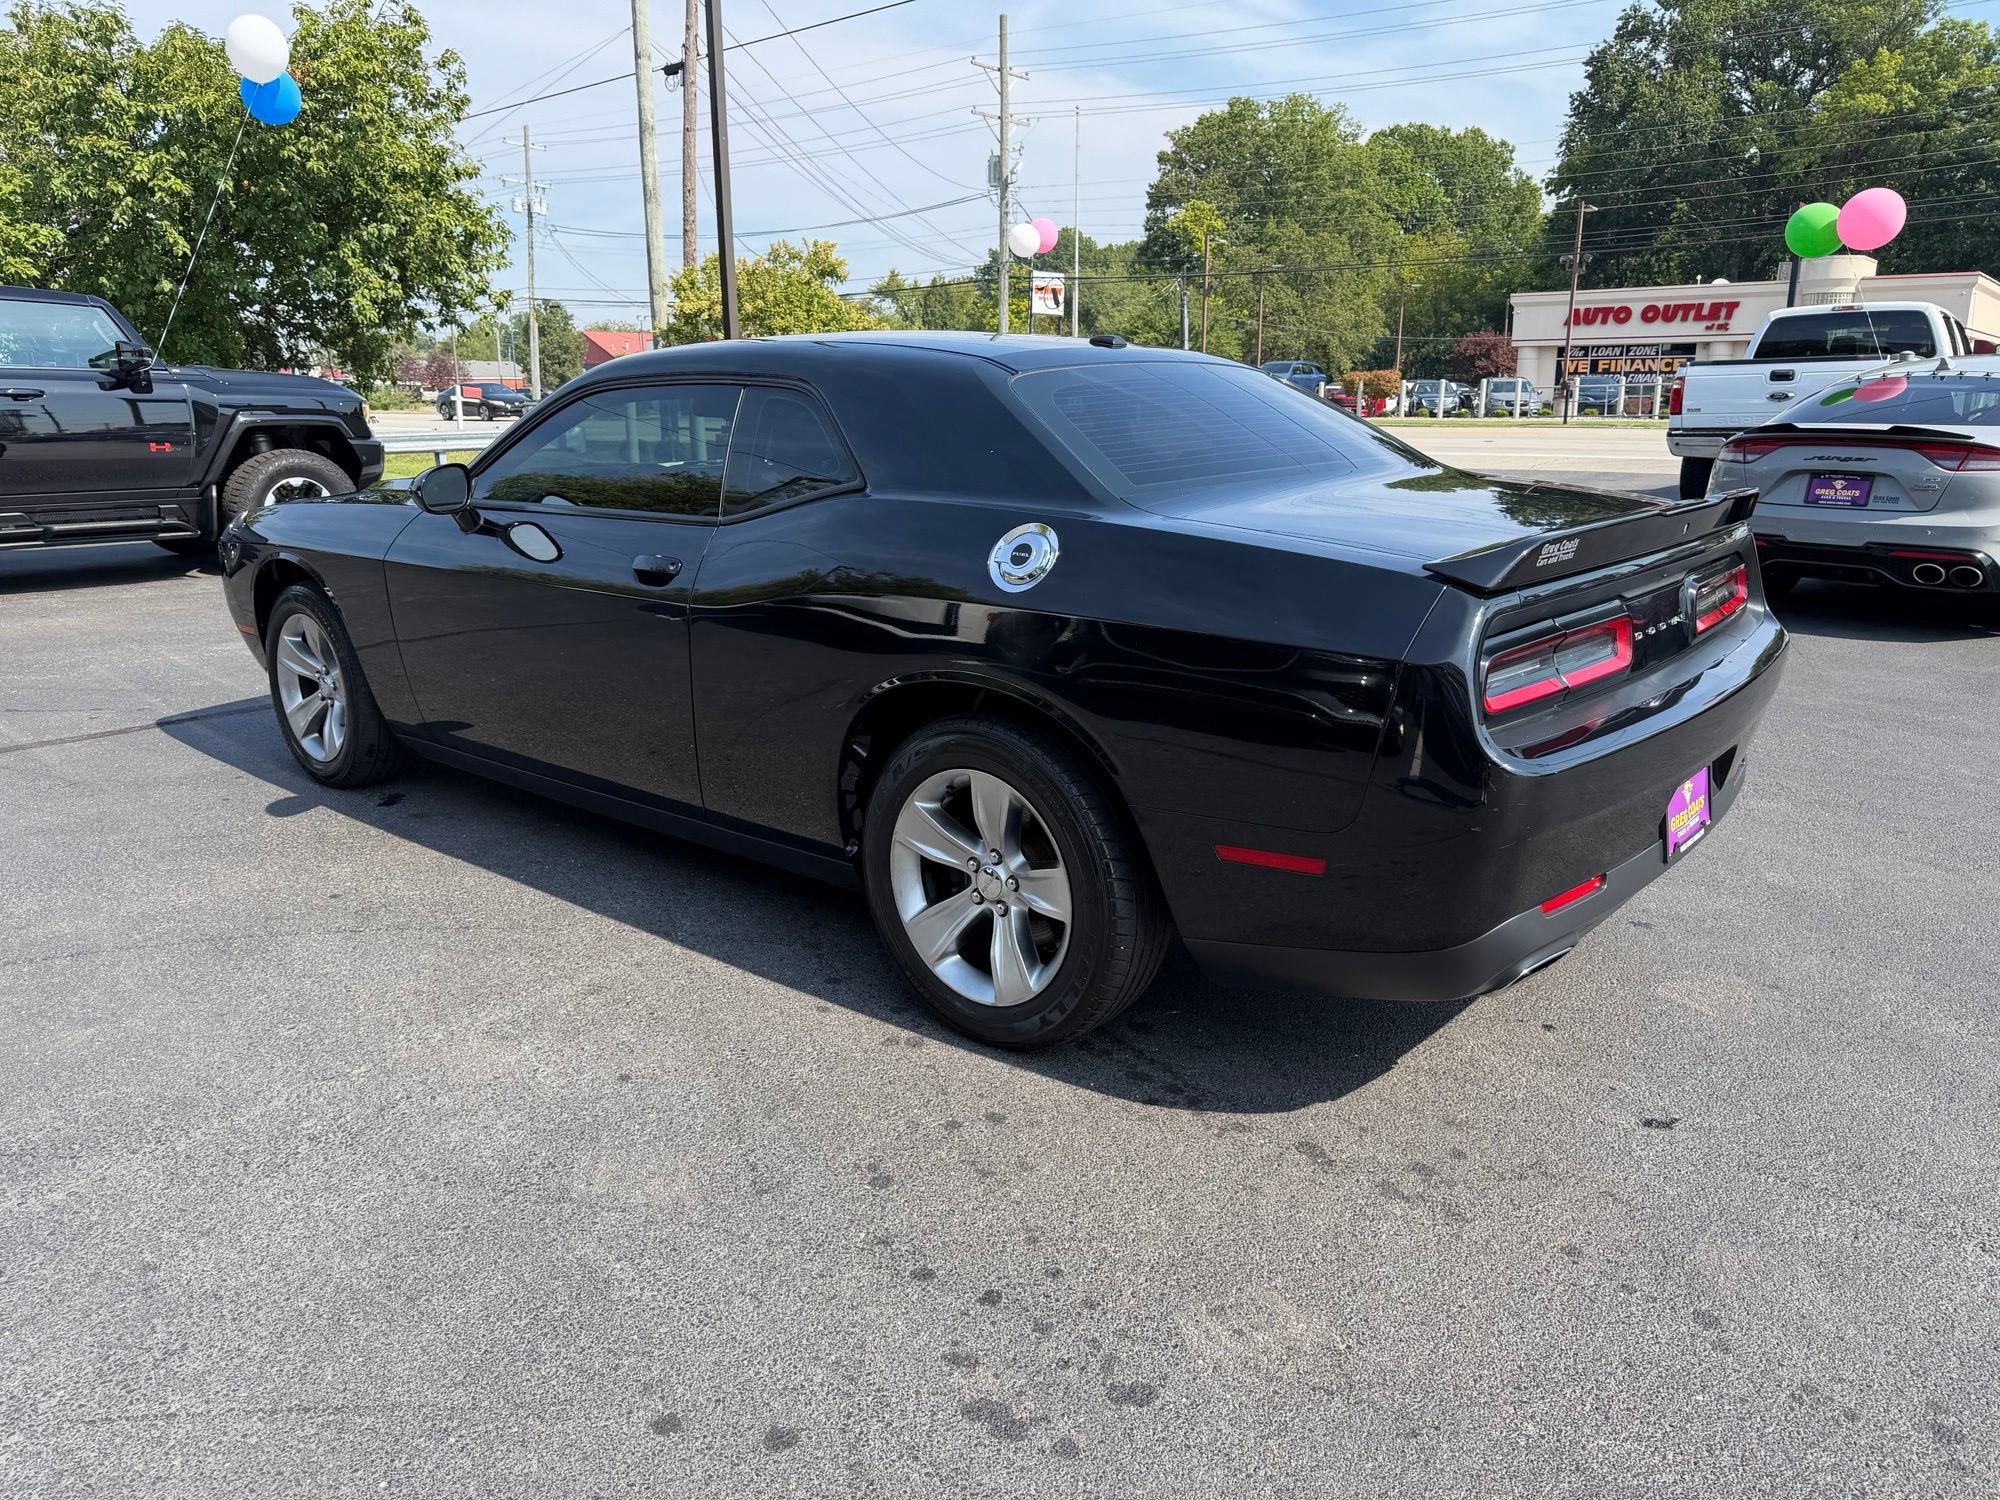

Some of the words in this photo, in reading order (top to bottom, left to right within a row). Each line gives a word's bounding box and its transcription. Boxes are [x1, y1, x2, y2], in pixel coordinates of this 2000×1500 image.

[1563, 305, 1632, 326] AUTO
[1640, 301, 1740, 324] OUTLET
[1592, 346, 1622, 357] LOAN
[1628, 345, 1658, 356] ZONE
[1561, 359, 1588, 373] WE
[1598, 358, 1685, 373] FINANCE
[1836, 489, 1860, 497] COATS
[1541, 543, 1560, 556] Greg
[1559, 537, 1580, 551] Coats
[1671, 809, 1688, 832] GREG
